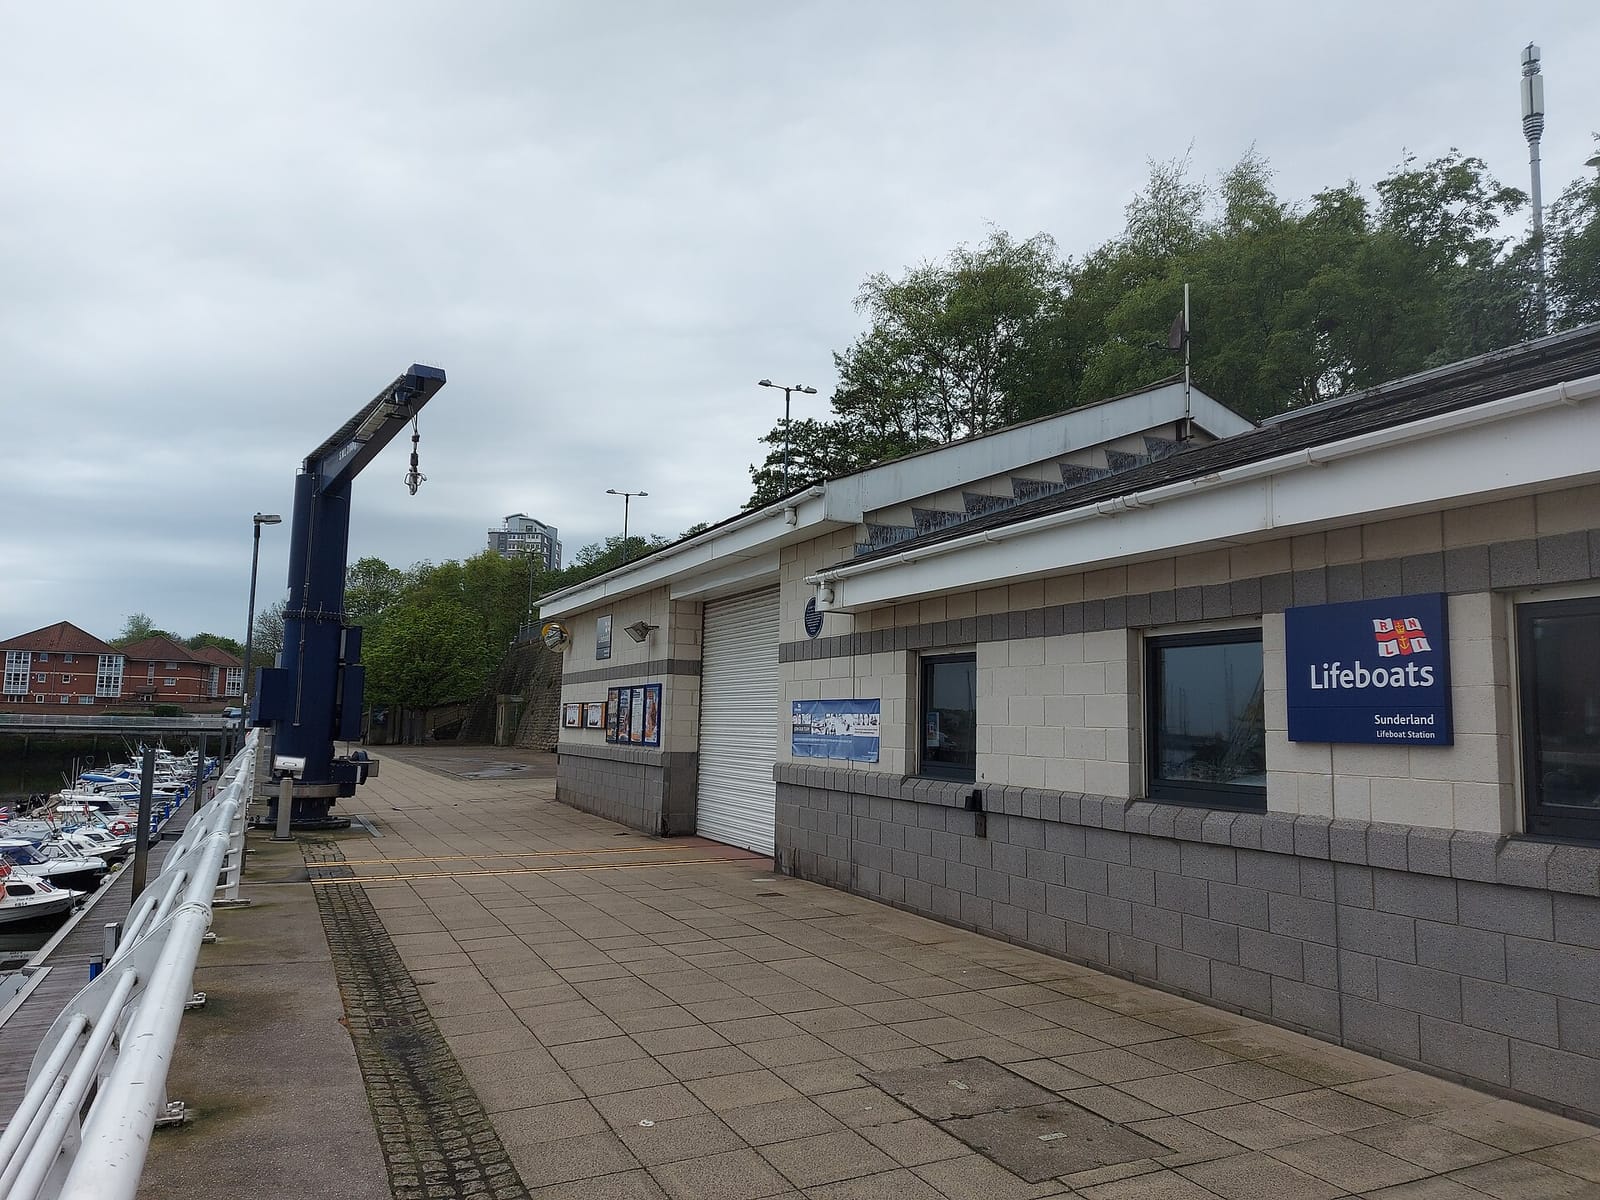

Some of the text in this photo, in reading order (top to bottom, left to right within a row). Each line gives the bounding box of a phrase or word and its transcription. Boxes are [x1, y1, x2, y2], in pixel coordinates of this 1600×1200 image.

[1310, 661, 1434, 689] Lifeboats
[1374, 714, 1434, 725] Sunderland
[1376, 730, 1436, 739] Lifeboat Station
